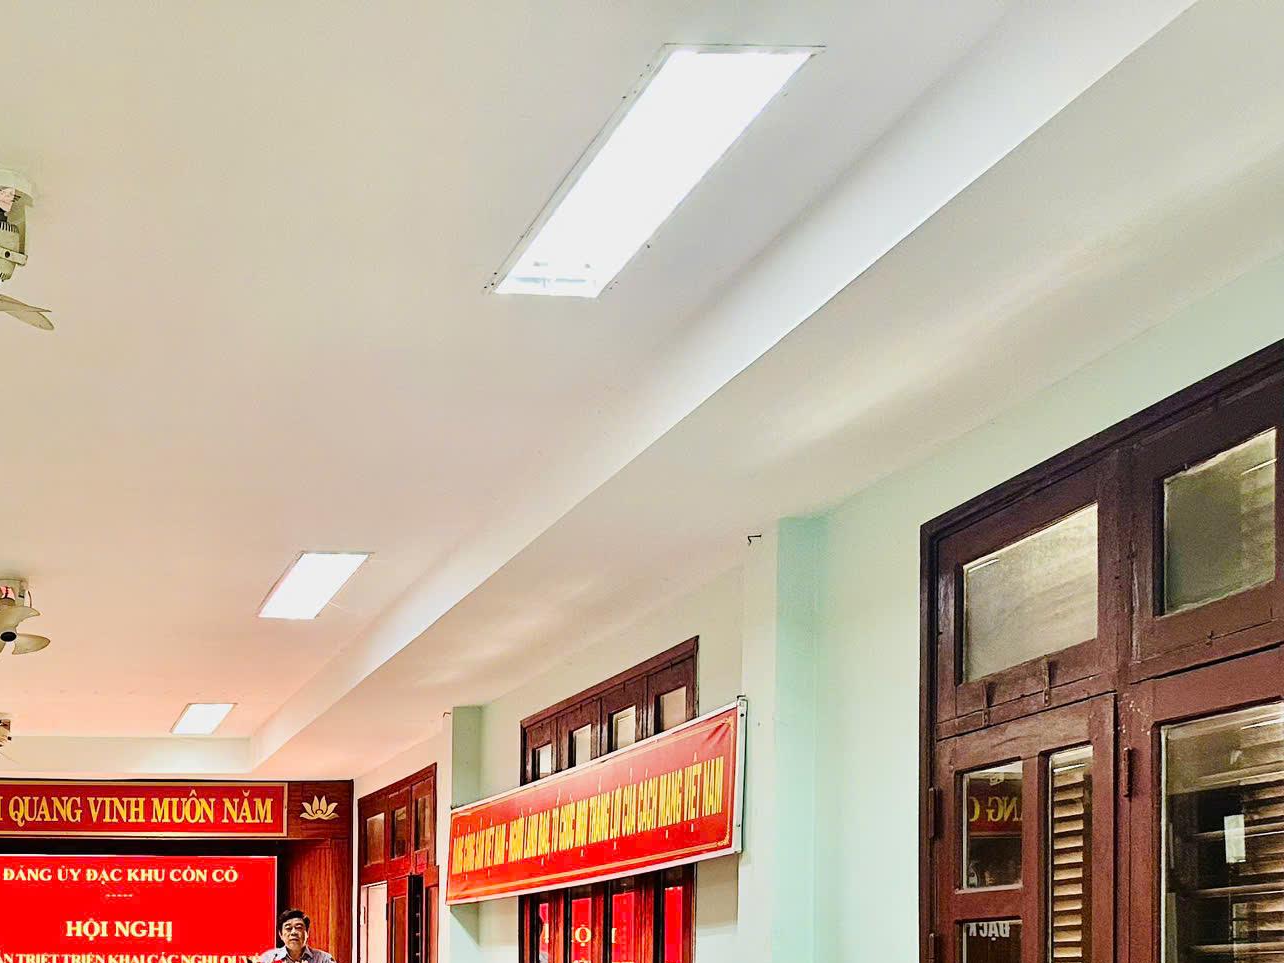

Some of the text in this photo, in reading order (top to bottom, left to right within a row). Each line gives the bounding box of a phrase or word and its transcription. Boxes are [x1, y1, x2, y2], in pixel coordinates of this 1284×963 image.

[637, 768, 658, 833] CÁCH
[684, 752, 702, 833] VIỆT
[702, 756, 724, 817] NAM
[8, 795, 82, 827] QUANG
[87, 796, 145, 823] VINH
[150, 790, 215, 823] MUÔN
[221, 790, 274, 824] NĂM
[3, 865, 52, 881] ĐẢNG
[57, 865, 81, 881] ỦY
[127, 868, 165, 882] KHU
[211, 866, 238, 882] CỎ
[66, 918, 173, 942] HỘI NGHỊ
